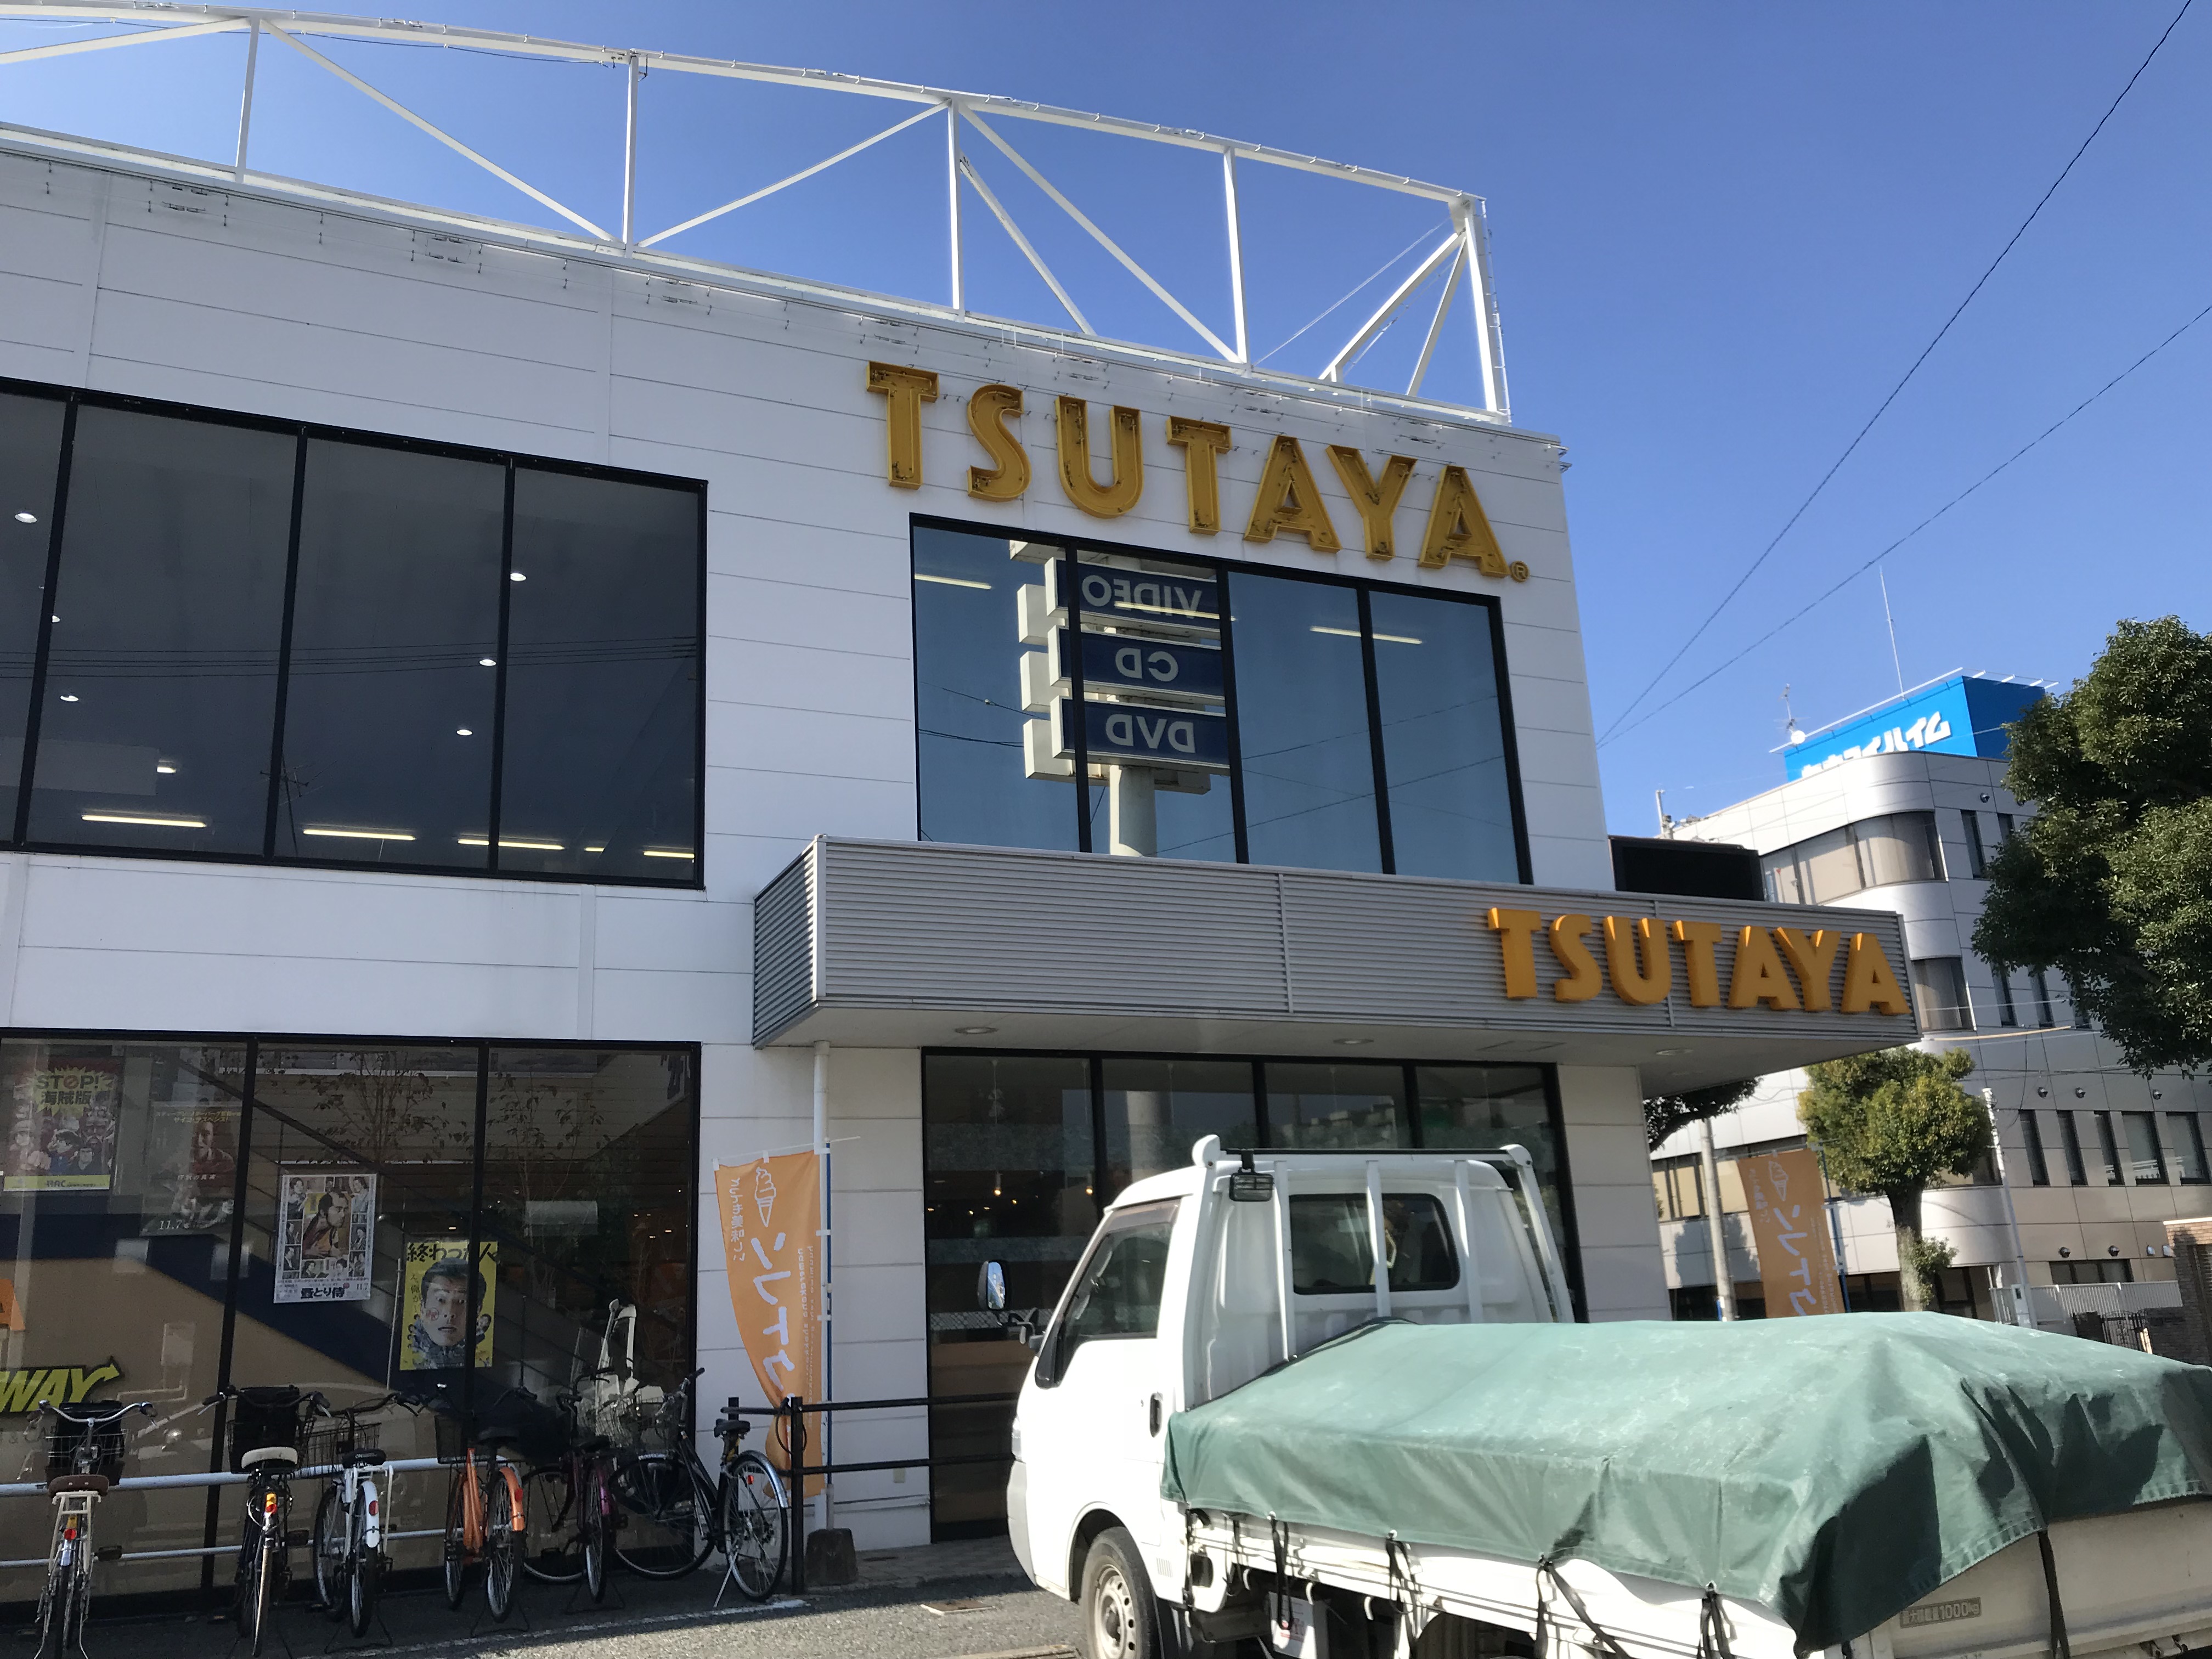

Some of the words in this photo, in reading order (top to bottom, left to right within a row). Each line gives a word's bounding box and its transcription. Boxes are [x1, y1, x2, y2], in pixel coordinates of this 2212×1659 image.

[1488, 907, 1912, 1015] TSUTAYA
[36, 1075, 99, 1090] STOP!
[42, 1091, 92, 1105] 海賊版
